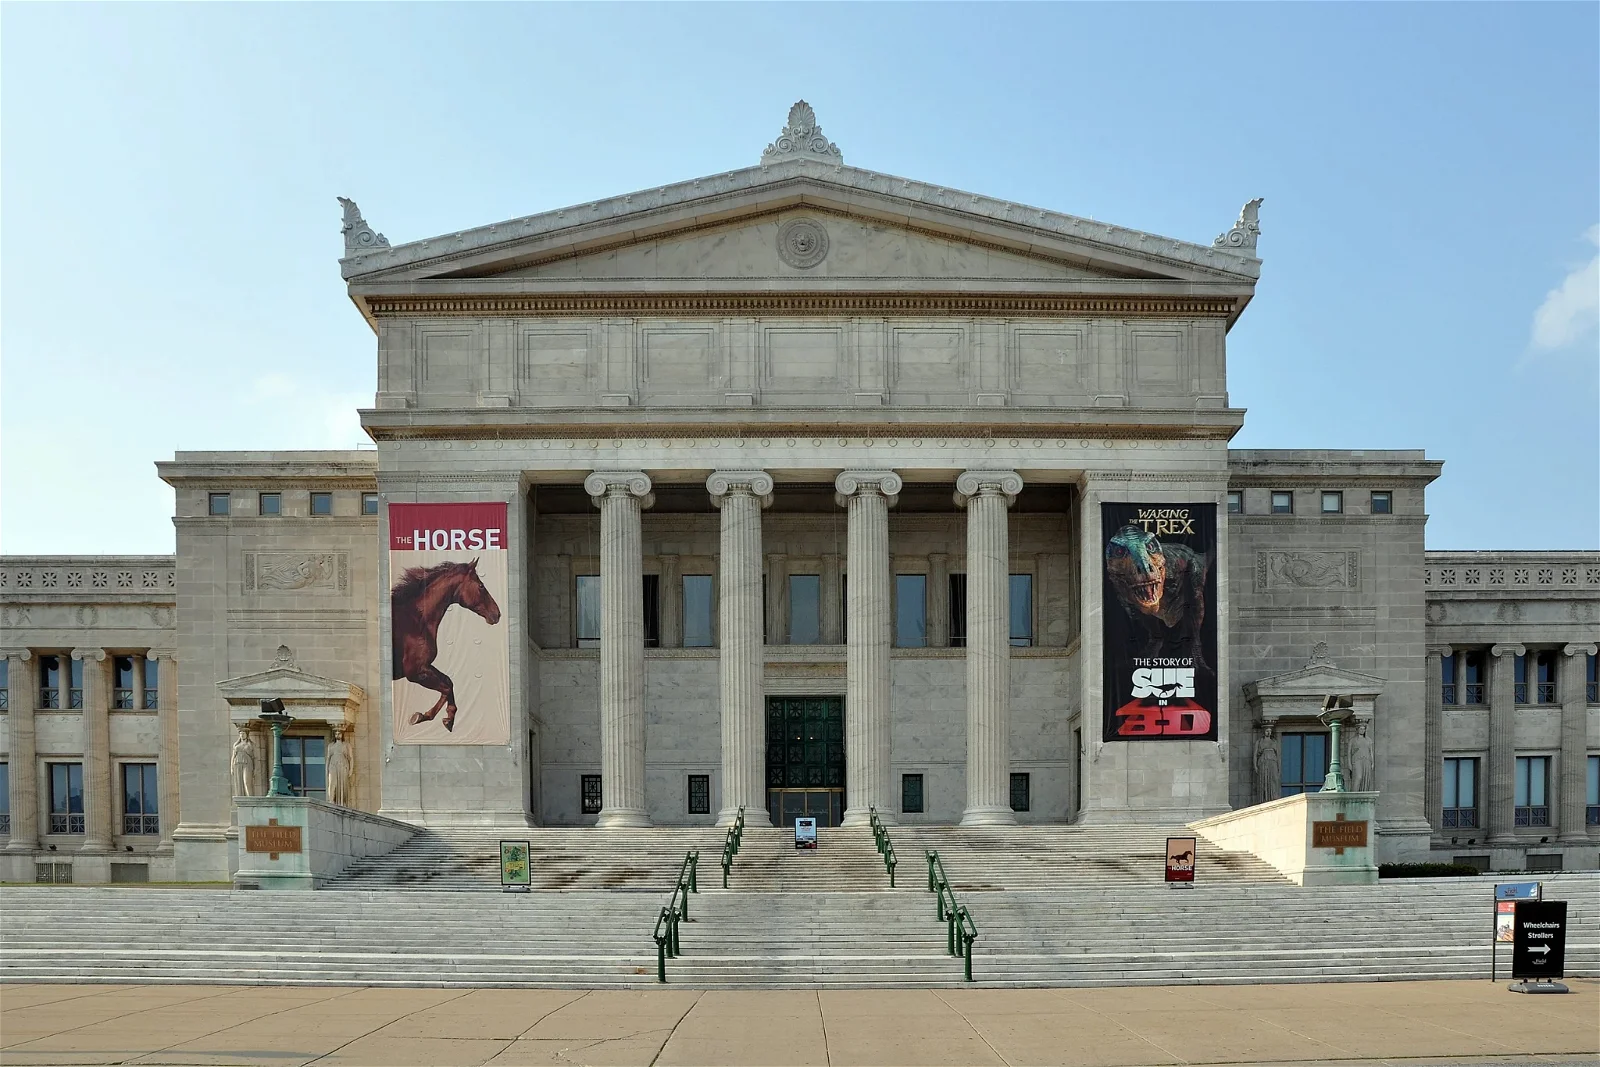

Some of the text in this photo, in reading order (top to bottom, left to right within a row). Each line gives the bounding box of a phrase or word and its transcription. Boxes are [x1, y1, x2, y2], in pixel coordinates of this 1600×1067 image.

[1138, 508, 1189, 519] WAKING
[395, 528, 501, 551] THE HORSE
[1133, 657, 1193, 666] THE STORY OF
[1131, 667, 1195, 698] SUE
[1340, 825, 1363, 833] FIELD
[253, 840, 293, 848] MUSEUM
[1523, 921, 1560, 929] Wheelchairs
